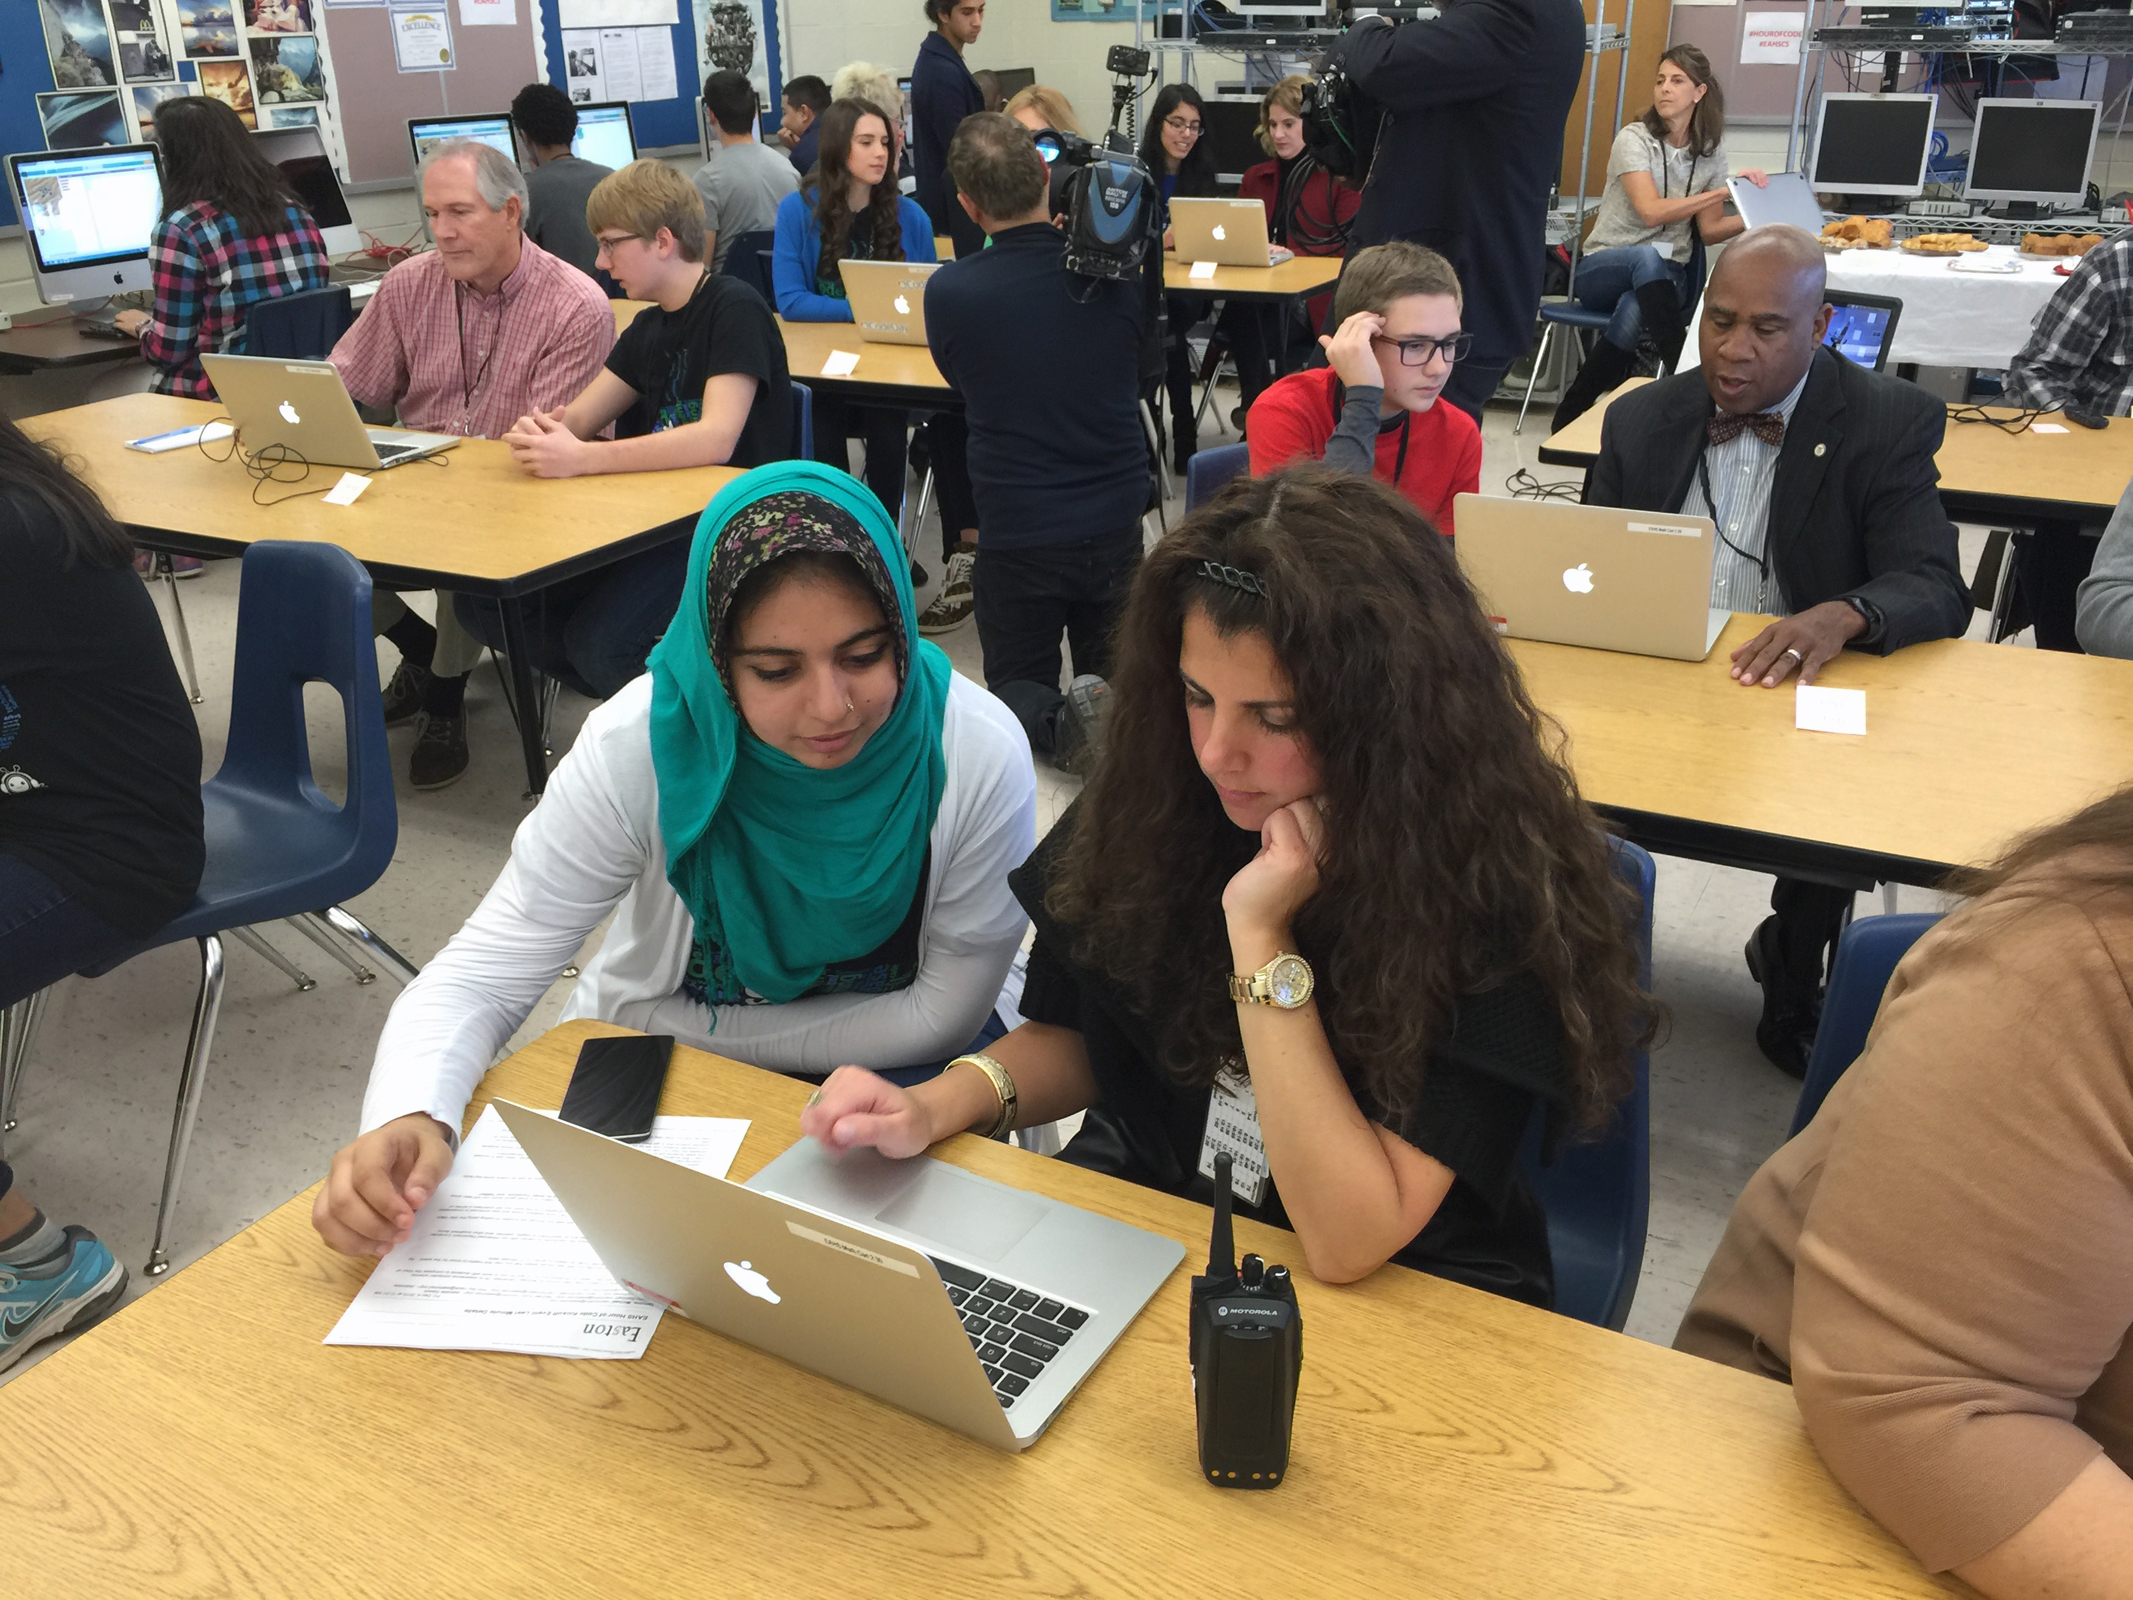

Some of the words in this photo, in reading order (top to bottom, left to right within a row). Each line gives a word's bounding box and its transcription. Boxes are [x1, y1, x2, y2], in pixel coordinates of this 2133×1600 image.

[401, 21, 441, 32] EXCELLENCE
[1229, 1308, 1278, 1316] MOTOROLA
[583, 1323, 641, 1343] Easton
